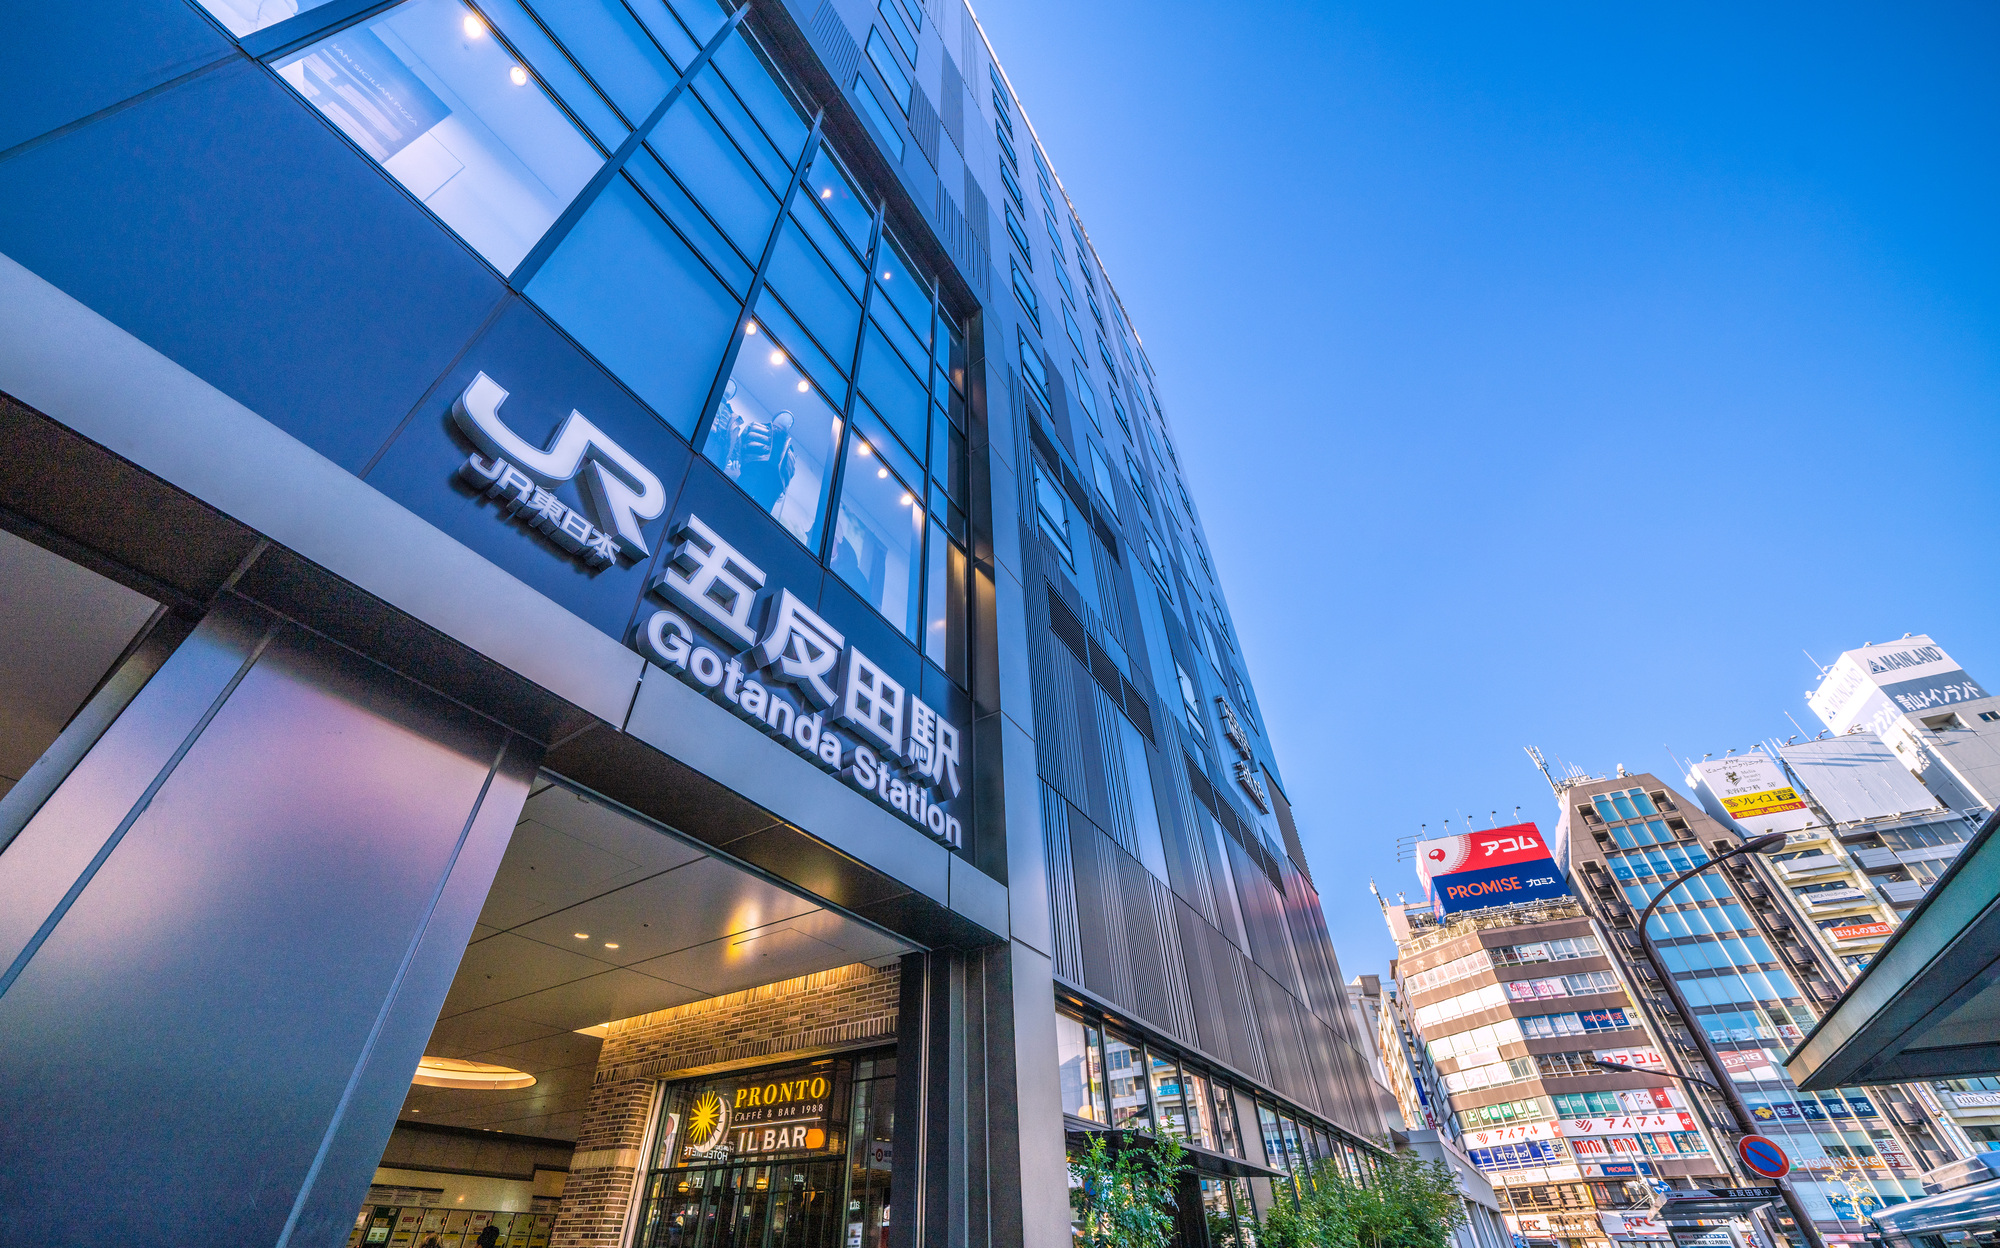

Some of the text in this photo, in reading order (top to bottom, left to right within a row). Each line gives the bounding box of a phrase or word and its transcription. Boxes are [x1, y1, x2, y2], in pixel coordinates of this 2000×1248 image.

[353, 63, 393, 101] SICILIAN
[394, 100, 418, 127] PIZZA
[460, 370, 667, 559] JR
[468, 452, 621, 566] JR東日本
[664, 513, 961, 799] 五反田駅
[1878, 646, 1943, 671] MAINLAND
[1894, 681, 1981, 712] 青山メインランド
[647, 610, 962, 849] Gotanda Station
[1480, 835, 1539, 857] アコム
[1446, 876, 1522, 900] PROMISE
[1525, 876, 1556, 887] プロミス
[1833, 925, 1886, 937] ほけんの窓口
[1583, 1012, 1624, 1023] PROMISE
[1615, 1053, 1662, 1066] アコム
[734, 1077, 826, 1109] PRONTO
[1656, 1091, 1665, 1101] 4F
[735, 1103, 824, 1122] CAFFÈ & BAR 1988
[1603, 1116, 1691, 1129] アイフル 4F
[738, 1131, 759, 1153] IL
[763, 1126, 807, 1151] BAR
[1496, 1126, 1539, 1140] アイフル
[1552, 1143, 1564, 1153] 3F
[1571, 1139, 1602, 1154] mini
[1794, 1153, 1883, 1169] English Pocket
[1884, 1154, 1911, 1167] 学童
[1516, 1220, 1541, 1231] KFC
